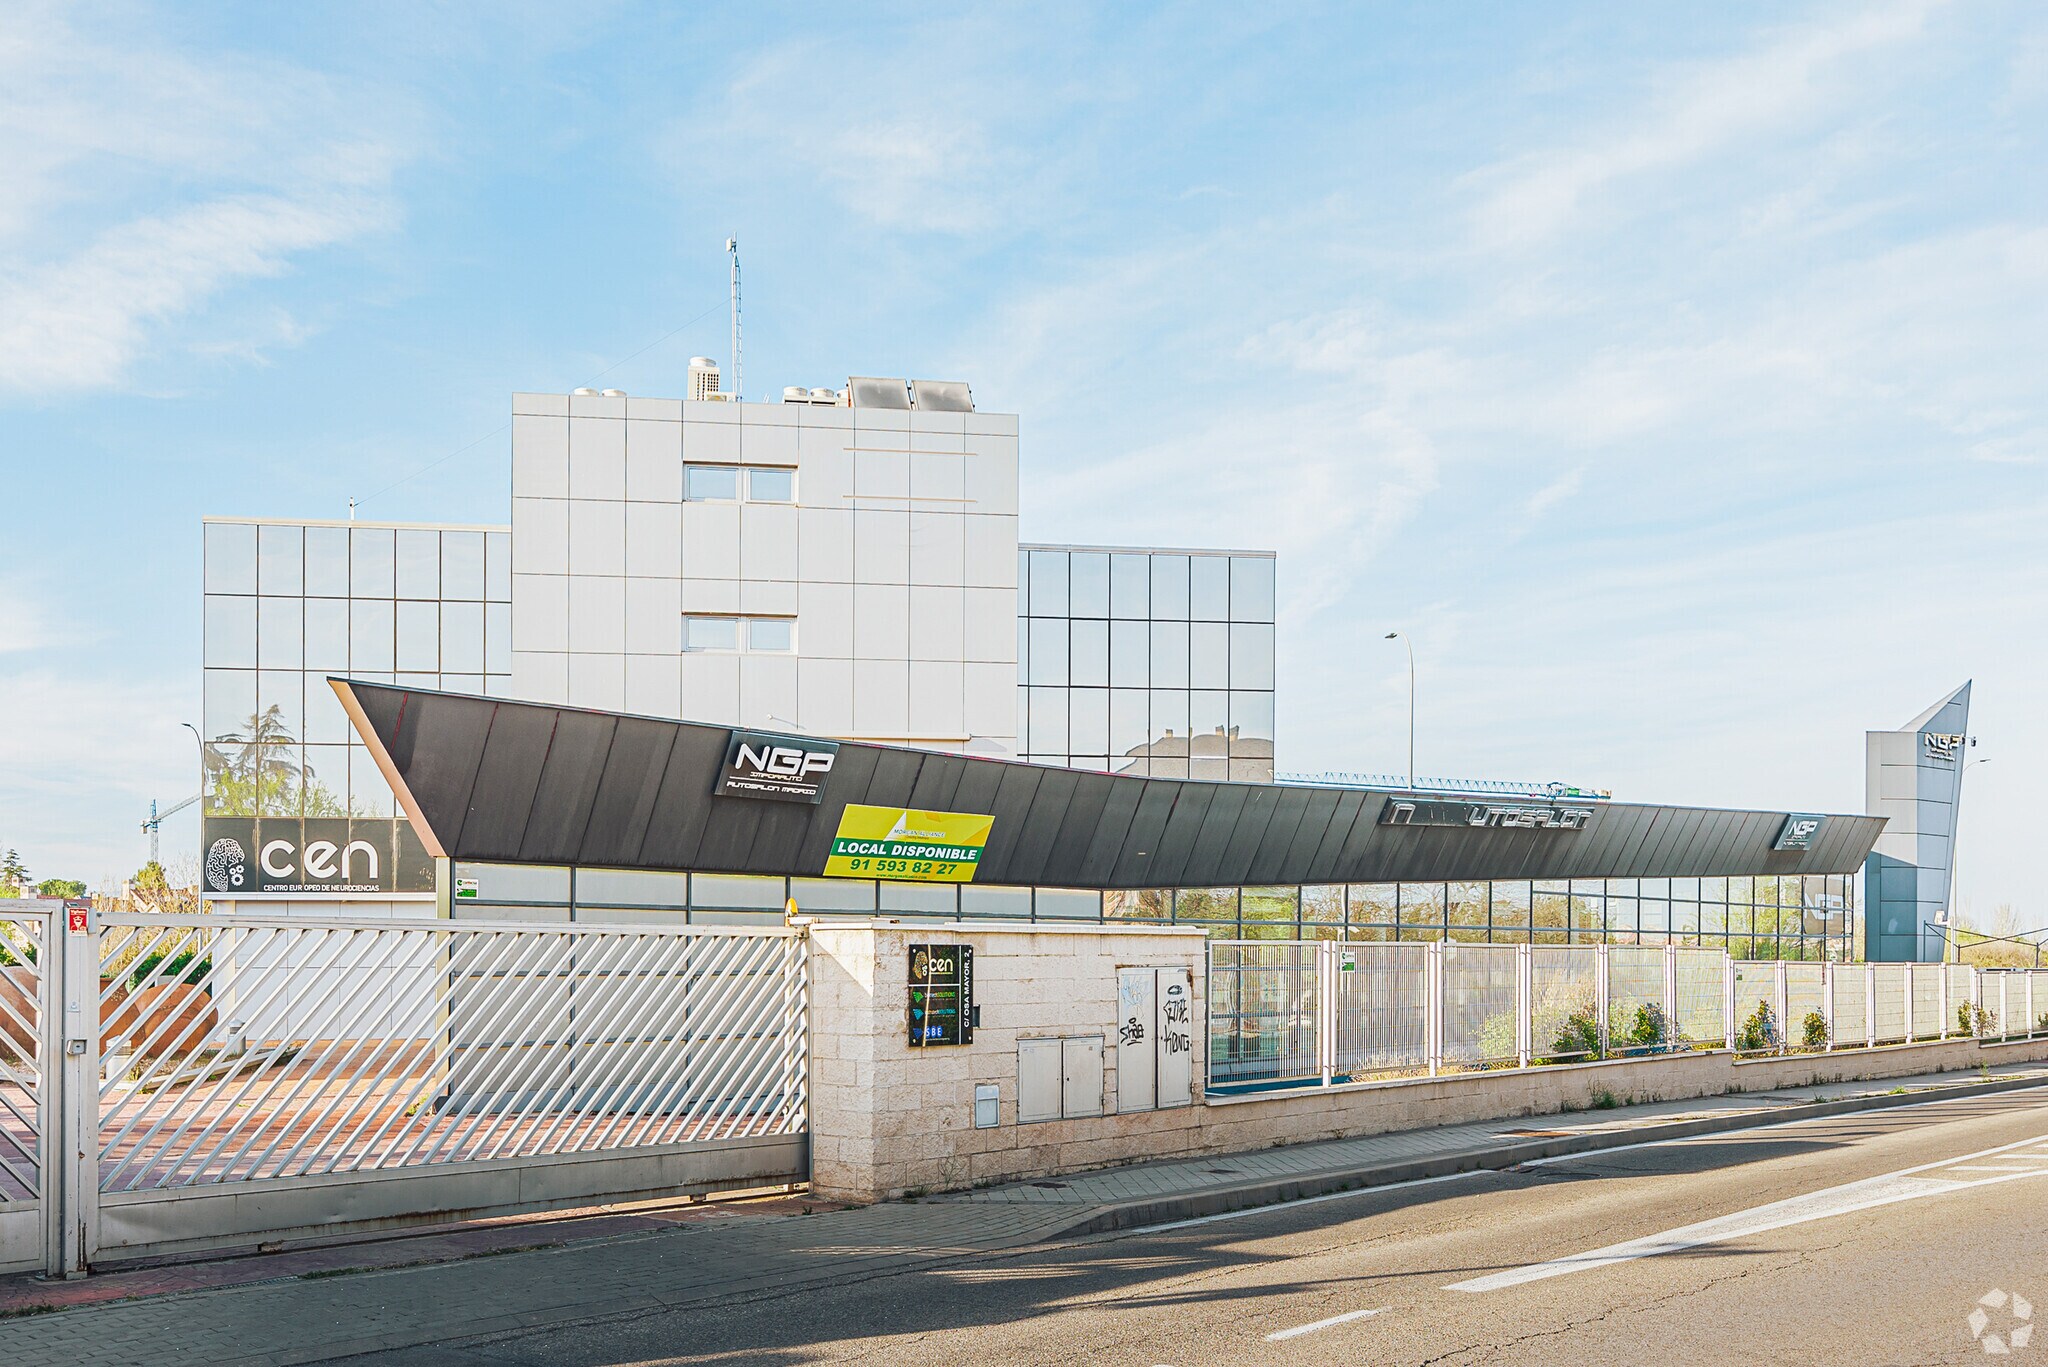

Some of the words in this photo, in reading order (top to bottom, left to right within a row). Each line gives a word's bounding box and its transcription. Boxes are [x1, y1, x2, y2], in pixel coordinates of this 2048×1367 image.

[735, 743, 835, 776] NGP
[726, 781, 780, 792] AUTOSALON
[782, 787, 817, 795] MADRID
[1788, 820, 1818, 836] NGP
[260, 839, 379, 879] cen
[837, 842, 886, 855] LOCAL
[891, 844, 977, 860] DISPONIBLE
[850, 859, 870, 871] 91
[876, 860, 907, 872] 593
[912, 862, 932, 874] 82
[936, 863, 957, 875] 27
[929, 958, 953, 972] cen
